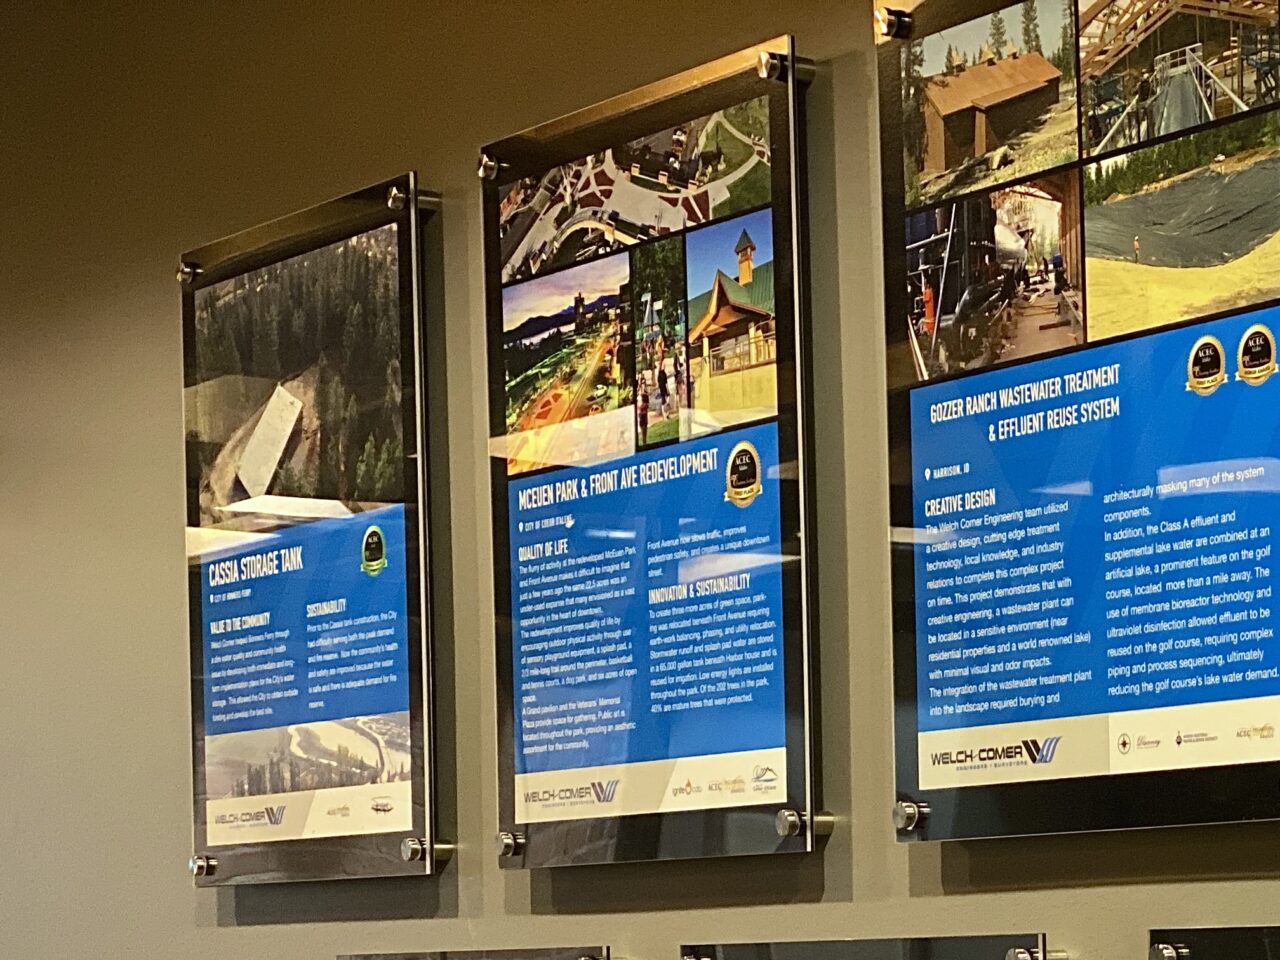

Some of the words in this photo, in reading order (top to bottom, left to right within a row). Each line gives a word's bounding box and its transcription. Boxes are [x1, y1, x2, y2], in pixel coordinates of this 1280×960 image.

[930, 398, 964, 422] GOZZER
[965, 391, 997, 416] RANCH
[999, 377, 1061, 408] WASTEWATER
[1063, 363, 1120, 394] TREATMENT
[988, 424, 996, 442] &
[998, 411, 1044, 440] EFFLUENT
[1047, 404, 1078, 430] REUSE
[1080, 396, 1119, 423] SYSTEM
[518, 484, 554, 510] MCEUEN
[555, 478, 579, 503] PARK
[580, 478, 588, 498] &
[589, 470, 618, 495] FRONT
[620, 466, 637, 489] AVE
[639, 448, 718, 485] REDEVELOPMENT
[924, 494, 962, 515] CREATIVE
[965, 489, 995, 510] DESIGN
[1104, 531, 1111, 541] In
[1112, 528, 1144, 541] addition,
[1146, 525, 1158, 535] the
[1159, 521, 1182, 533] Class
[1182, 518, 1189, 529] A
[1190, 514, 1219, 528] effluent
[1220, 510, 1236, 523] and
[209, 560, 239, 586] CASSIA
[240, 551, 278, 580] STORAGE
[280, 546, 302, 572] TANK
[518, 544, 543, 561] QUALITY
[545, 541, 552, 556] OF
[554, 538, 568, 555] LIFE
[648, 584, 687, 603] INNOVATION
[689, 584, 694, 598] &
[696, 574, 750, 596] SUSTAINABILITY
